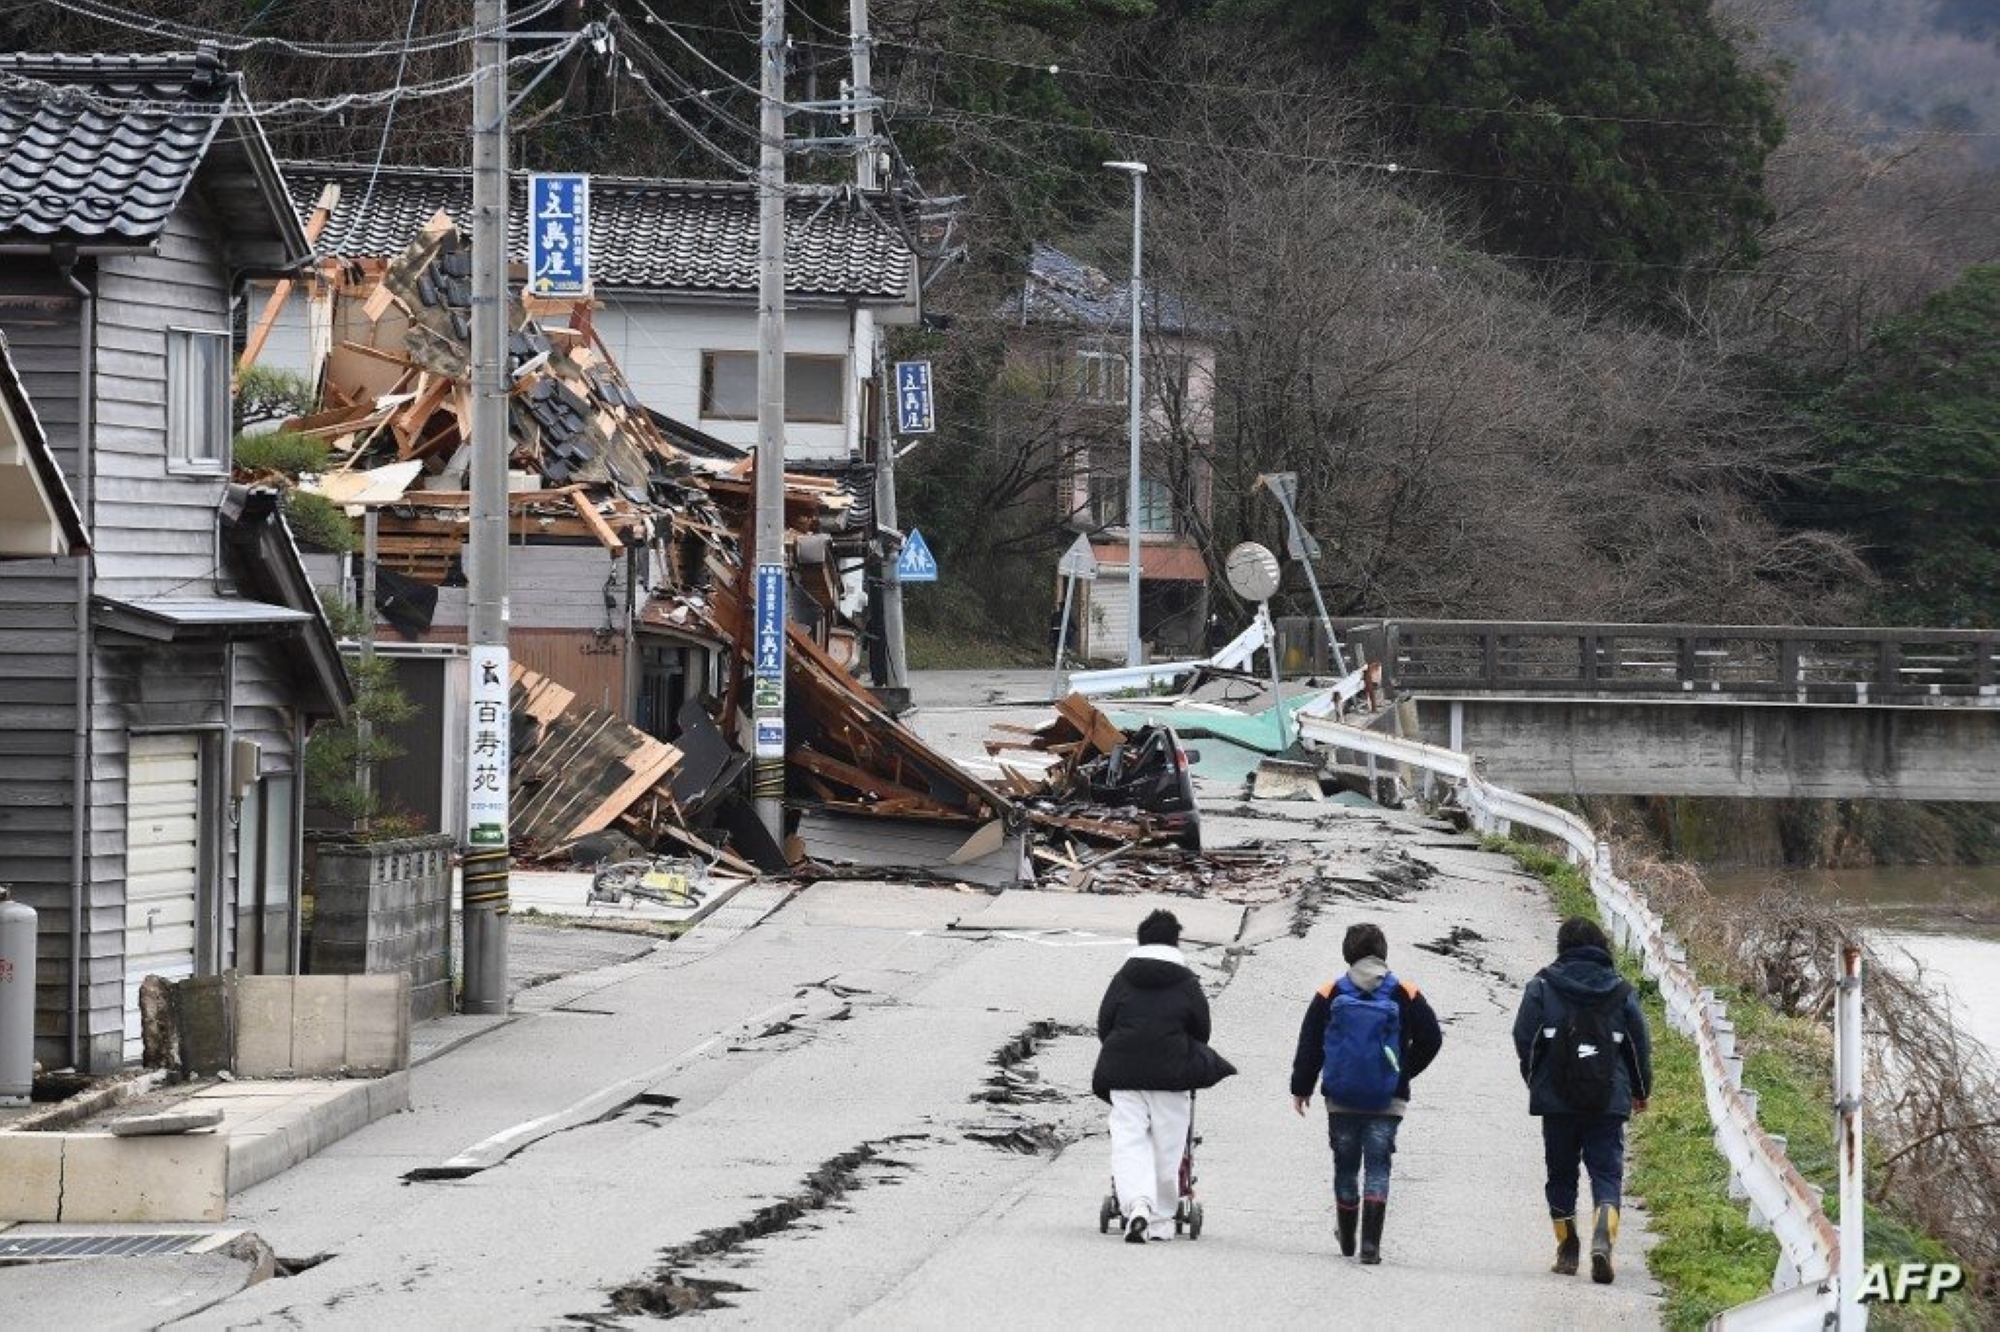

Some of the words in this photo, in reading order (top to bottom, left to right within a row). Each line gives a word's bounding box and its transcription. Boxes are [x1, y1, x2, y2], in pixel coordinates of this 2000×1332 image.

[536, 191, 573, 276] 五島屋
[473, 700, 503, 792] 百寿苑
